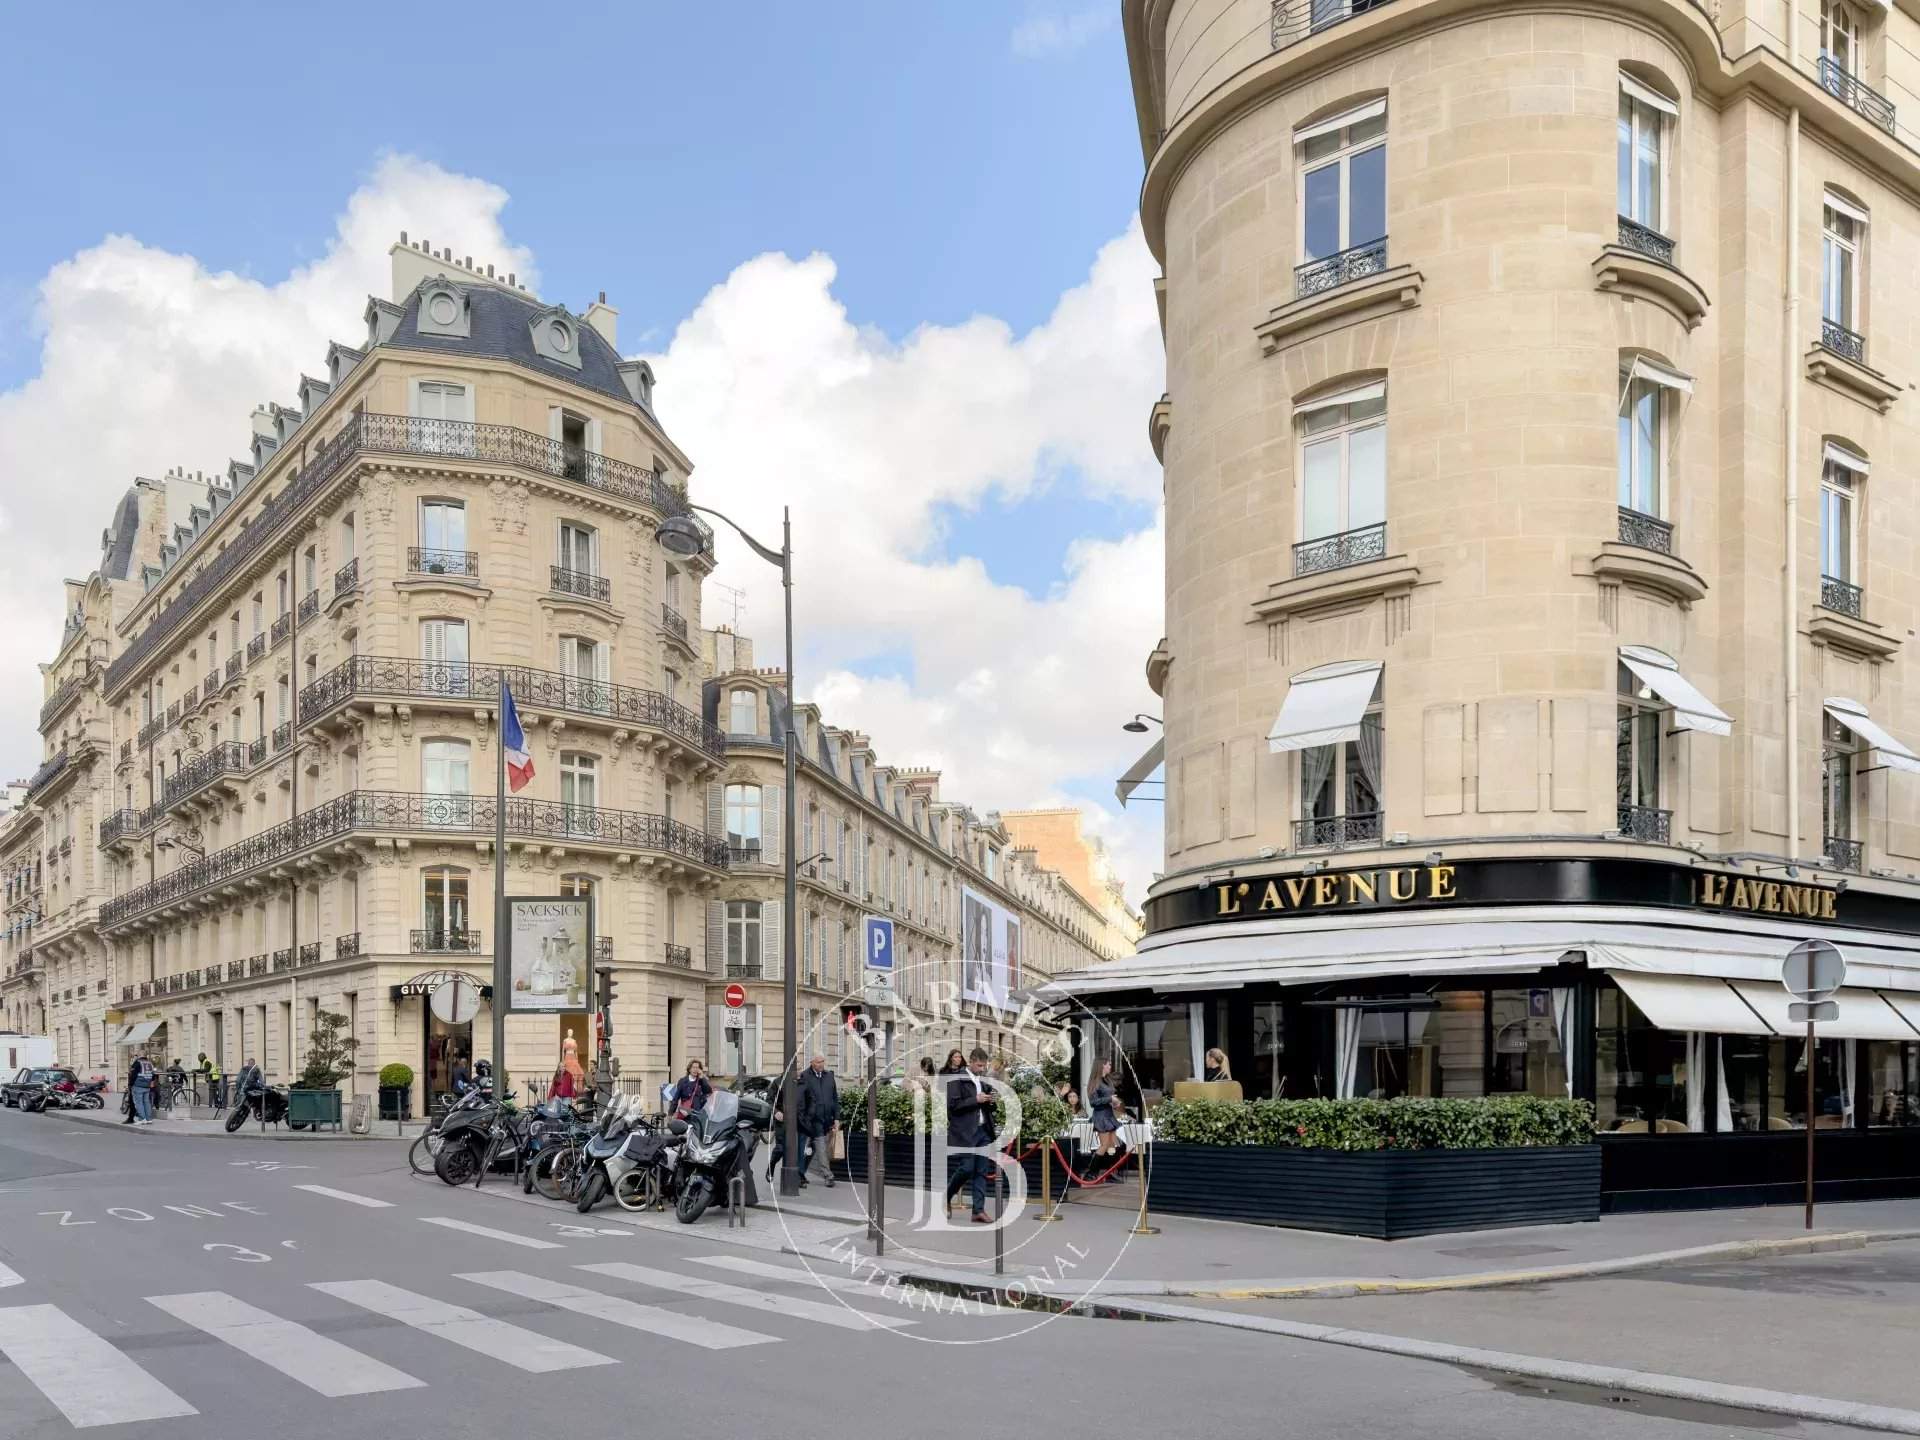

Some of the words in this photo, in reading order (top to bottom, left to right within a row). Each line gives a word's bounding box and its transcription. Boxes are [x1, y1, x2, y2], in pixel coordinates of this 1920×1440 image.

[517, 904, 583, 917] SACKSICK
[873, 928, 886, 959] P
[401, 985, 484, 995] GIVEY
